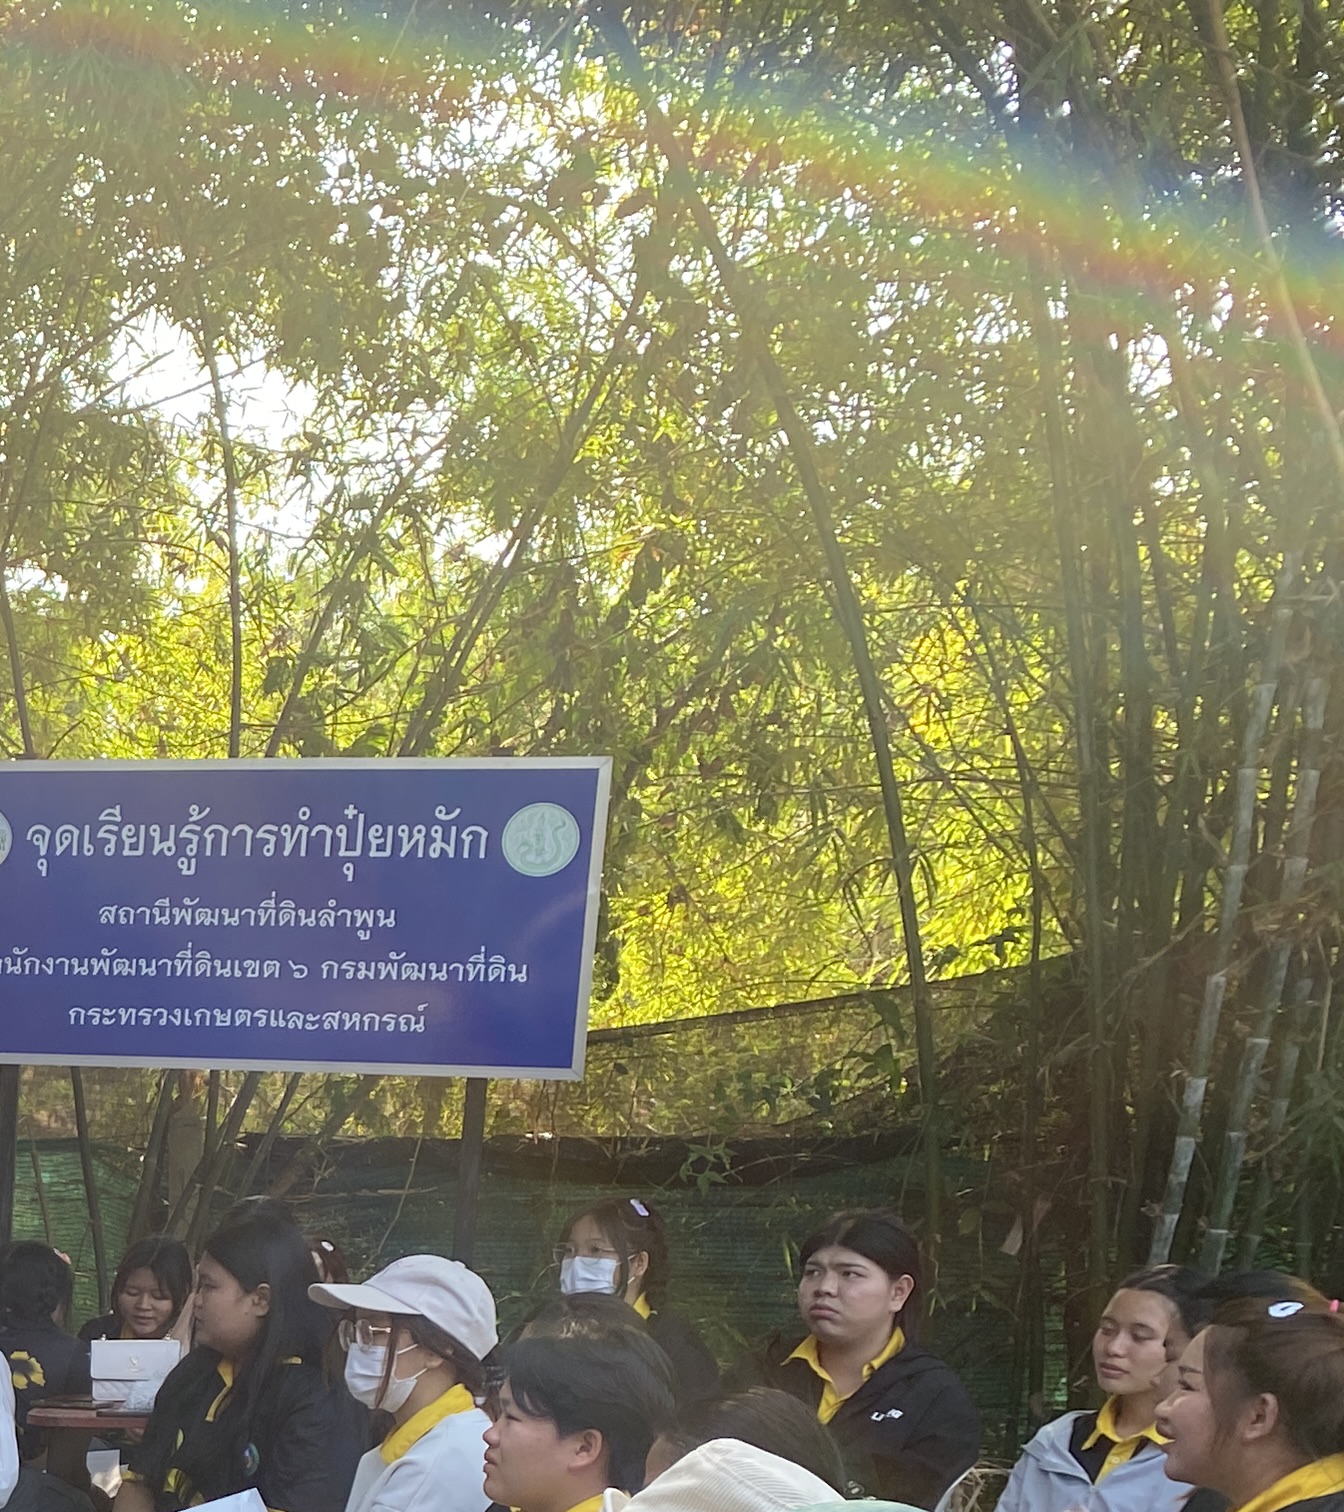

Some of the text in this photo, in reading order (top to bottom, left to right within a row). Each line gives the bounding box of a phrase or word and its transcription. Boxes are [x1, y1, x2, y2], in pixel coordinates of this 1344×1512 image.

[26, 804, 488, 882] จุดเรียนรู้การทำปุ๋ยหมัก
[98, 892, 397, 940] สถานีพัฒนาที่ดินลำพูน
[288, 960, 308, 982] ๖
[321, 946, 529, 985] กรมพัฒนาที่ดิน
[68, 1001, 427, 1034] กระทรวงเกษตรและสหกรณ์
